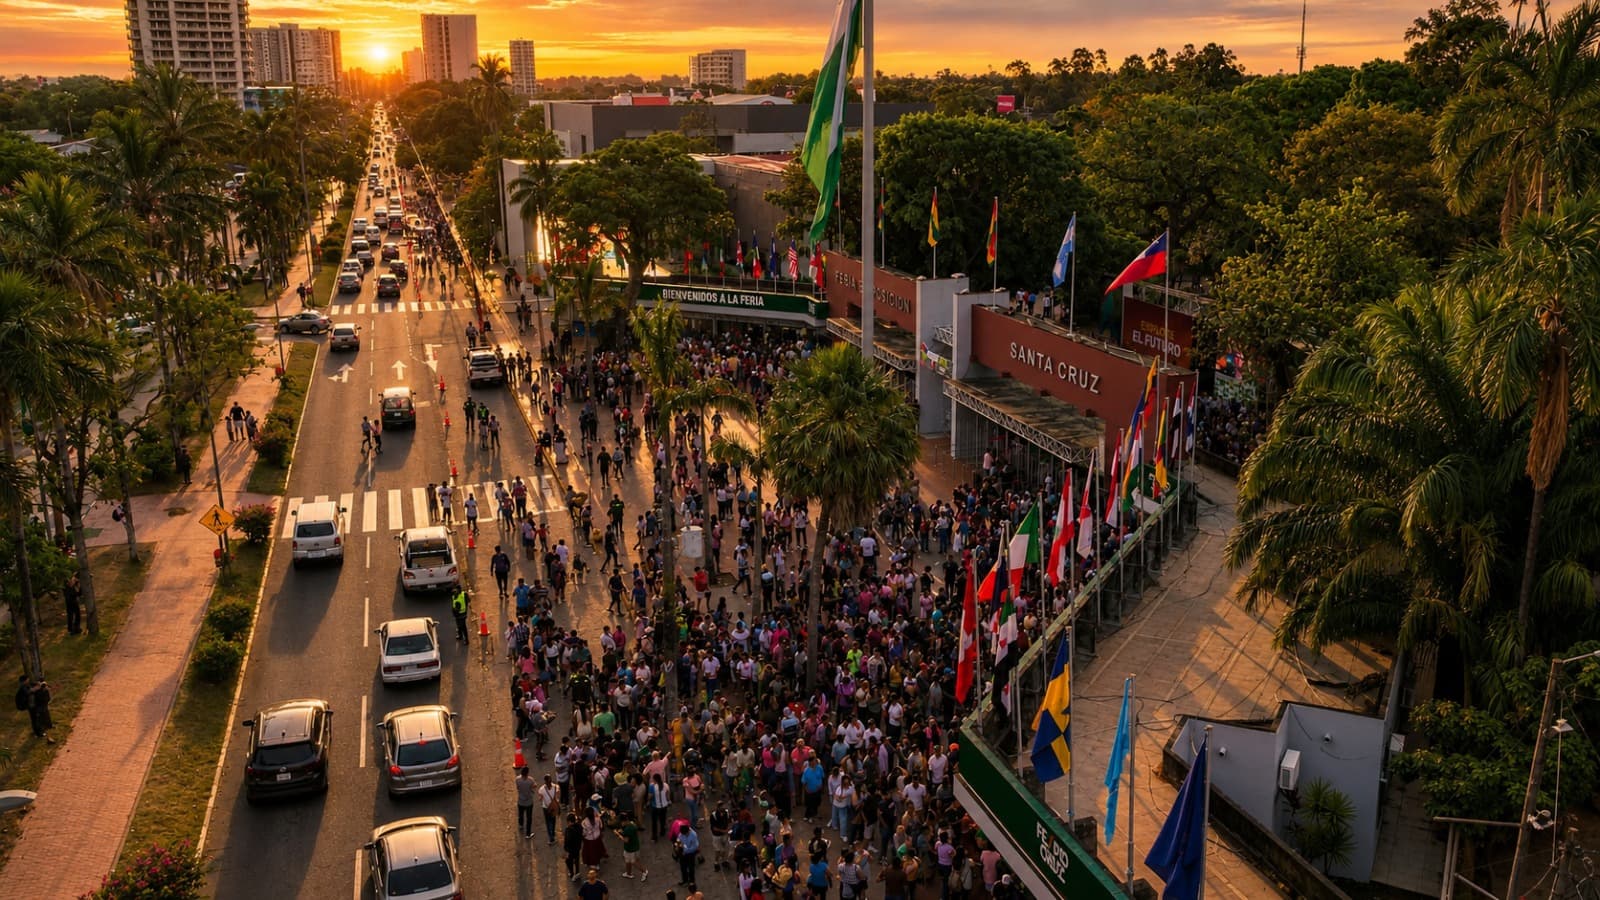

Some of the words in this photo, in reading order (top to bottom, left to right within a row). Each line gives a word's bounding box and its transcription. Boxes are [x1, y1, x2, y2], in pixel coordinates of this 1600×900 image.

[662, 288, 718, 303] BIENVENIDOS
[719, 294, 727, 304] A
[727, 294, 739, 305] LA
[740, 295, 765, 307] FERIA
[1132, 329, 1144, 345] EL
[1144, 334, 1181, 358] FUTURO
[1010, 341, 1053, 375] SANTA
[1057, 361, 1100, 394] CRUZ
